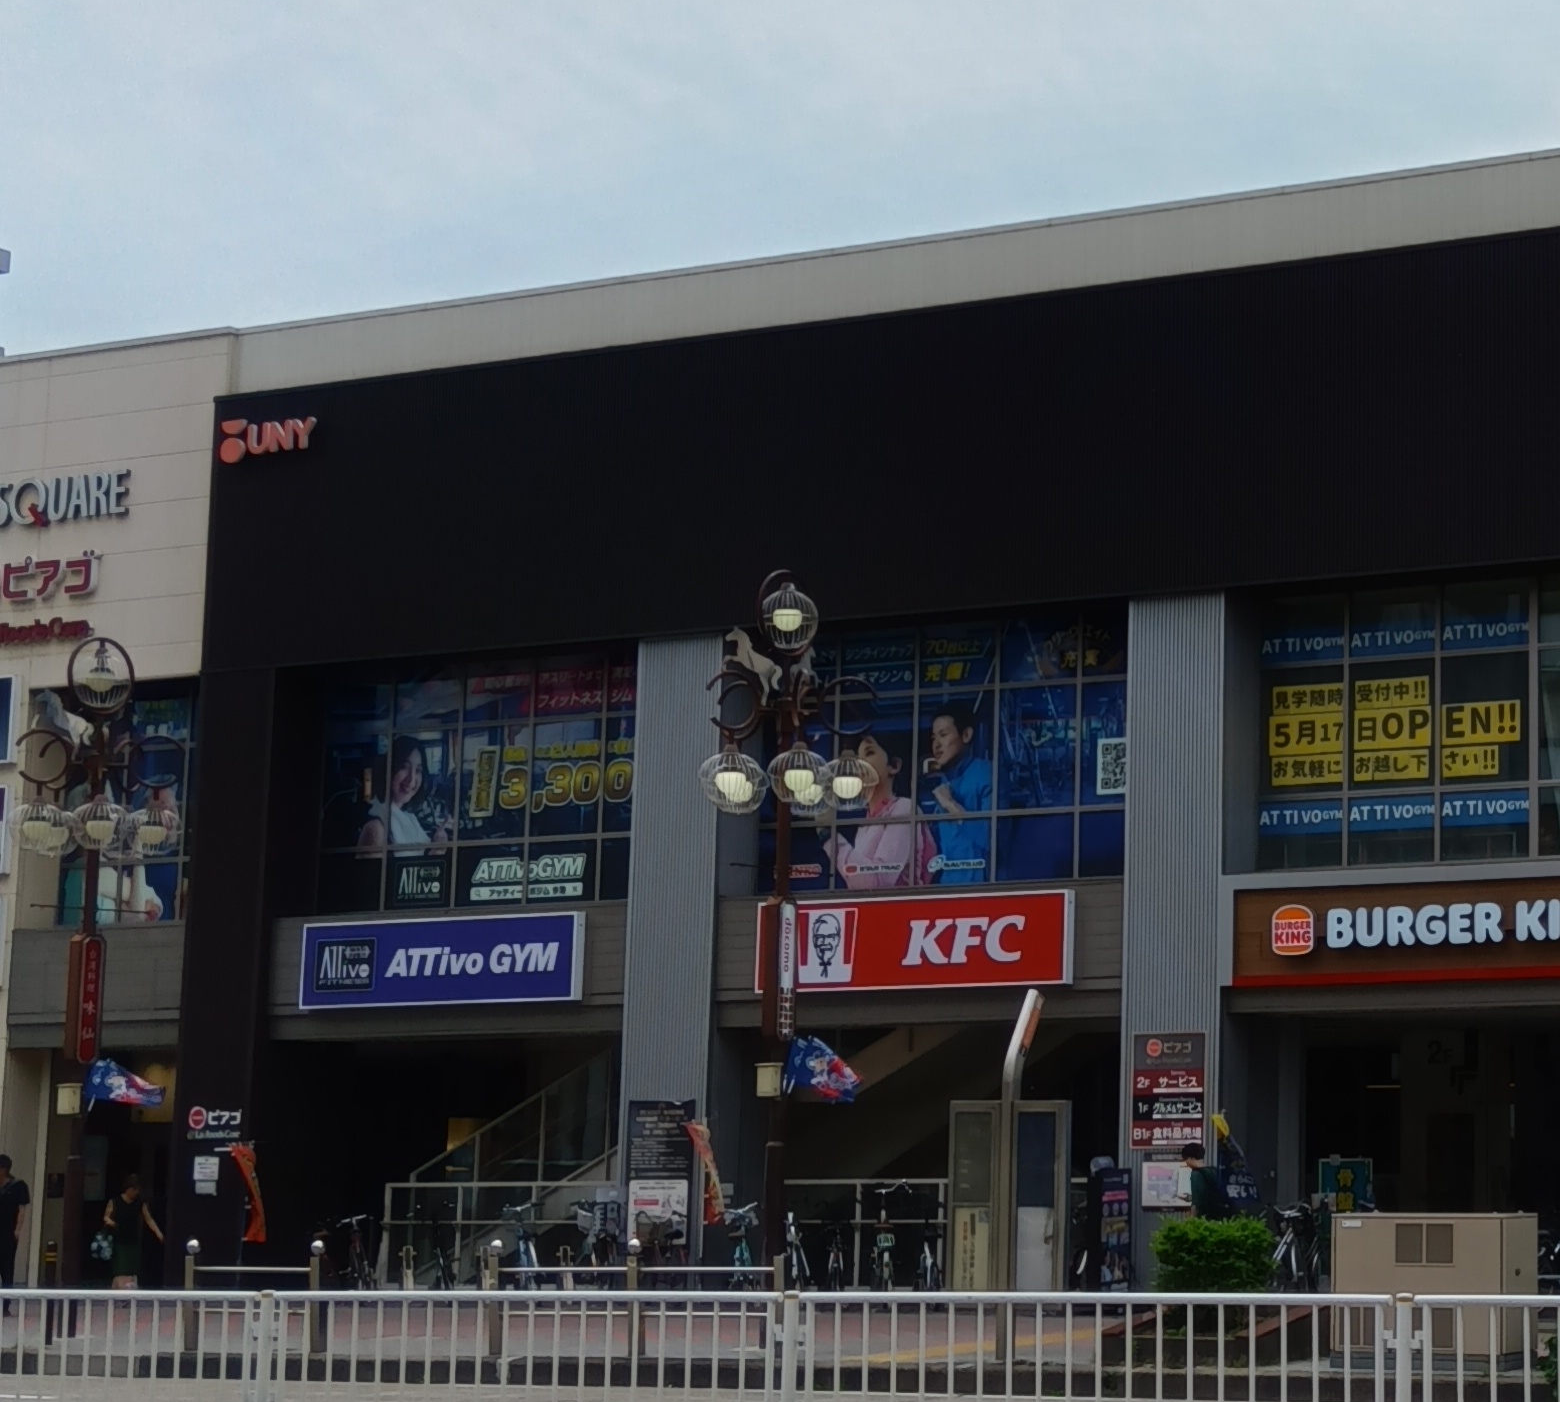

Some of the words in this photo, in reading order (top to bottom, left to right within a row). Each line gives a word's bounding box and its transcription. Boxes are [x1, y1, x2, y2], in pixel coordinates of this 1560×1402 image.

[247, 416, 317, 454] UNY
[3, 549, 98, 599] ピアゴ
[1275, 920, 1311, 932] BURGER
[1327, 902, 1504, 948] BURGER
[901, 915, 1026, 967] KFC
[1275, 930, 1311, 946] KING
[384, 947, 484, 978] ATTivo
[489, 942, 559, 974] GYM
[1136, 1077, 1151, 1089] 2F
[1158, 1075, 1198, 1088] サービス
[1138, 1102, 1149, 1114] 1F
[208, 1108, 242, 1125] ピアゴ
[1133, 1128, 1152, 1140] B1F
